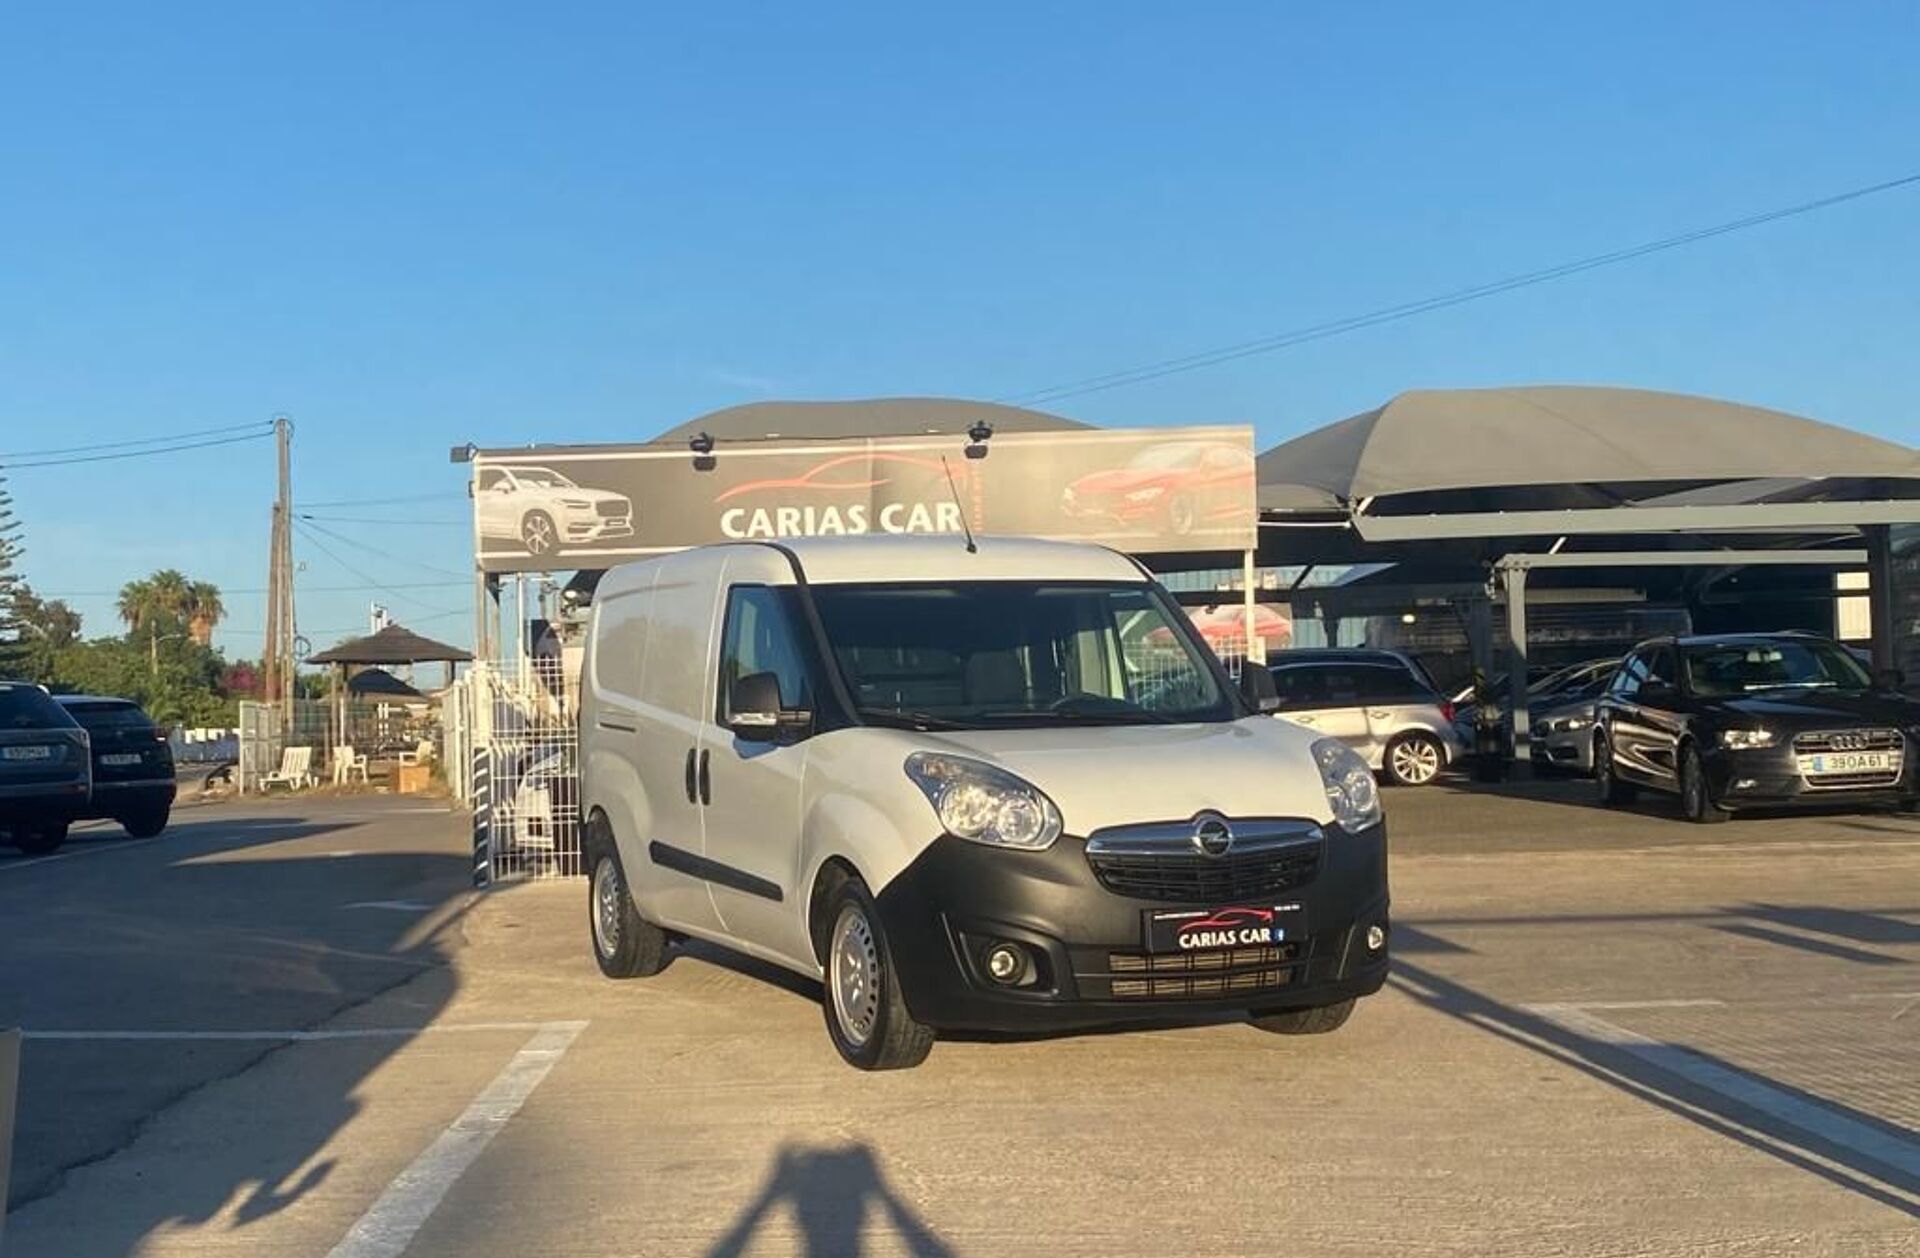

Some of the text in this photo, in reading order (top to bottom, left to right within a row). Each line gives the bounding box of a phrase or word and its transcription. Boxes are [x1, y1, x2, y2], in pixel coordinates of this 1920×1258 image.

[720, 504, 868, 538] CARIAS
[879, 502, 962, 533] CAR
[1179, 930, 1237, 948] CARIAS
[1239, 928, 1271, 943] CAR
